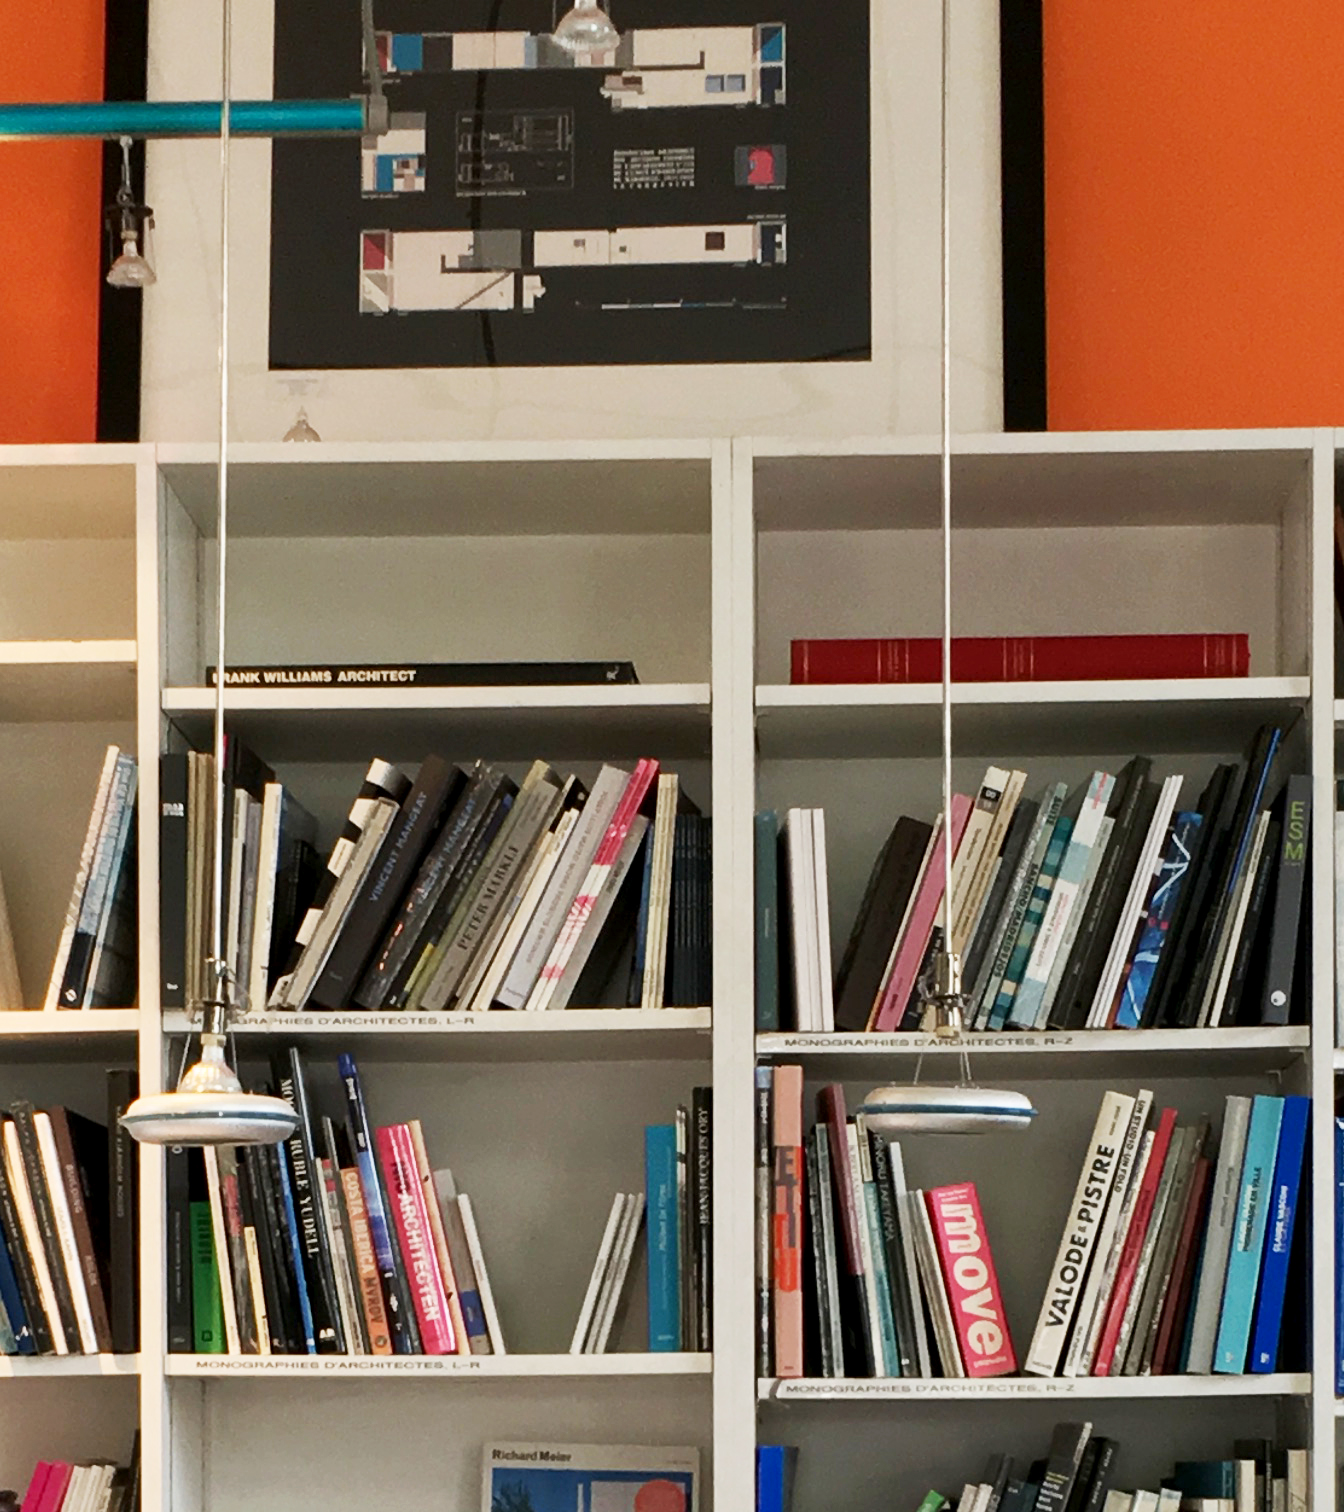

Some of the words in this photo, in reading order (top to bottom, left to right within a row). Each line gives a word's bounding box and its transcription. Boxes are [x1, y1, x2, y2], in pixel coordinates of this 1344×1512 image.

[263, 670, 332, 684] WILLIAMS
[336, 669, 417, 683] ARCHITECT
[1284, 800, 1305, 860] ESM
[456, 901, 488, 951] PETER
[290, 1139, 309, 1192] RUBLE
[298, 1196, 320, 1259] YUDELL
[397, 1189, 443, 1322] ARCHITECTEN
[1044, 1232, 1089, 1329] VALODE
[1076, 1143, 1116, 1224] PISTRE
[941, 1201, 1006, 1356] move
[491, 1448, 538, 1461] Richard
[538, 1449, 572, 1462] Meier
